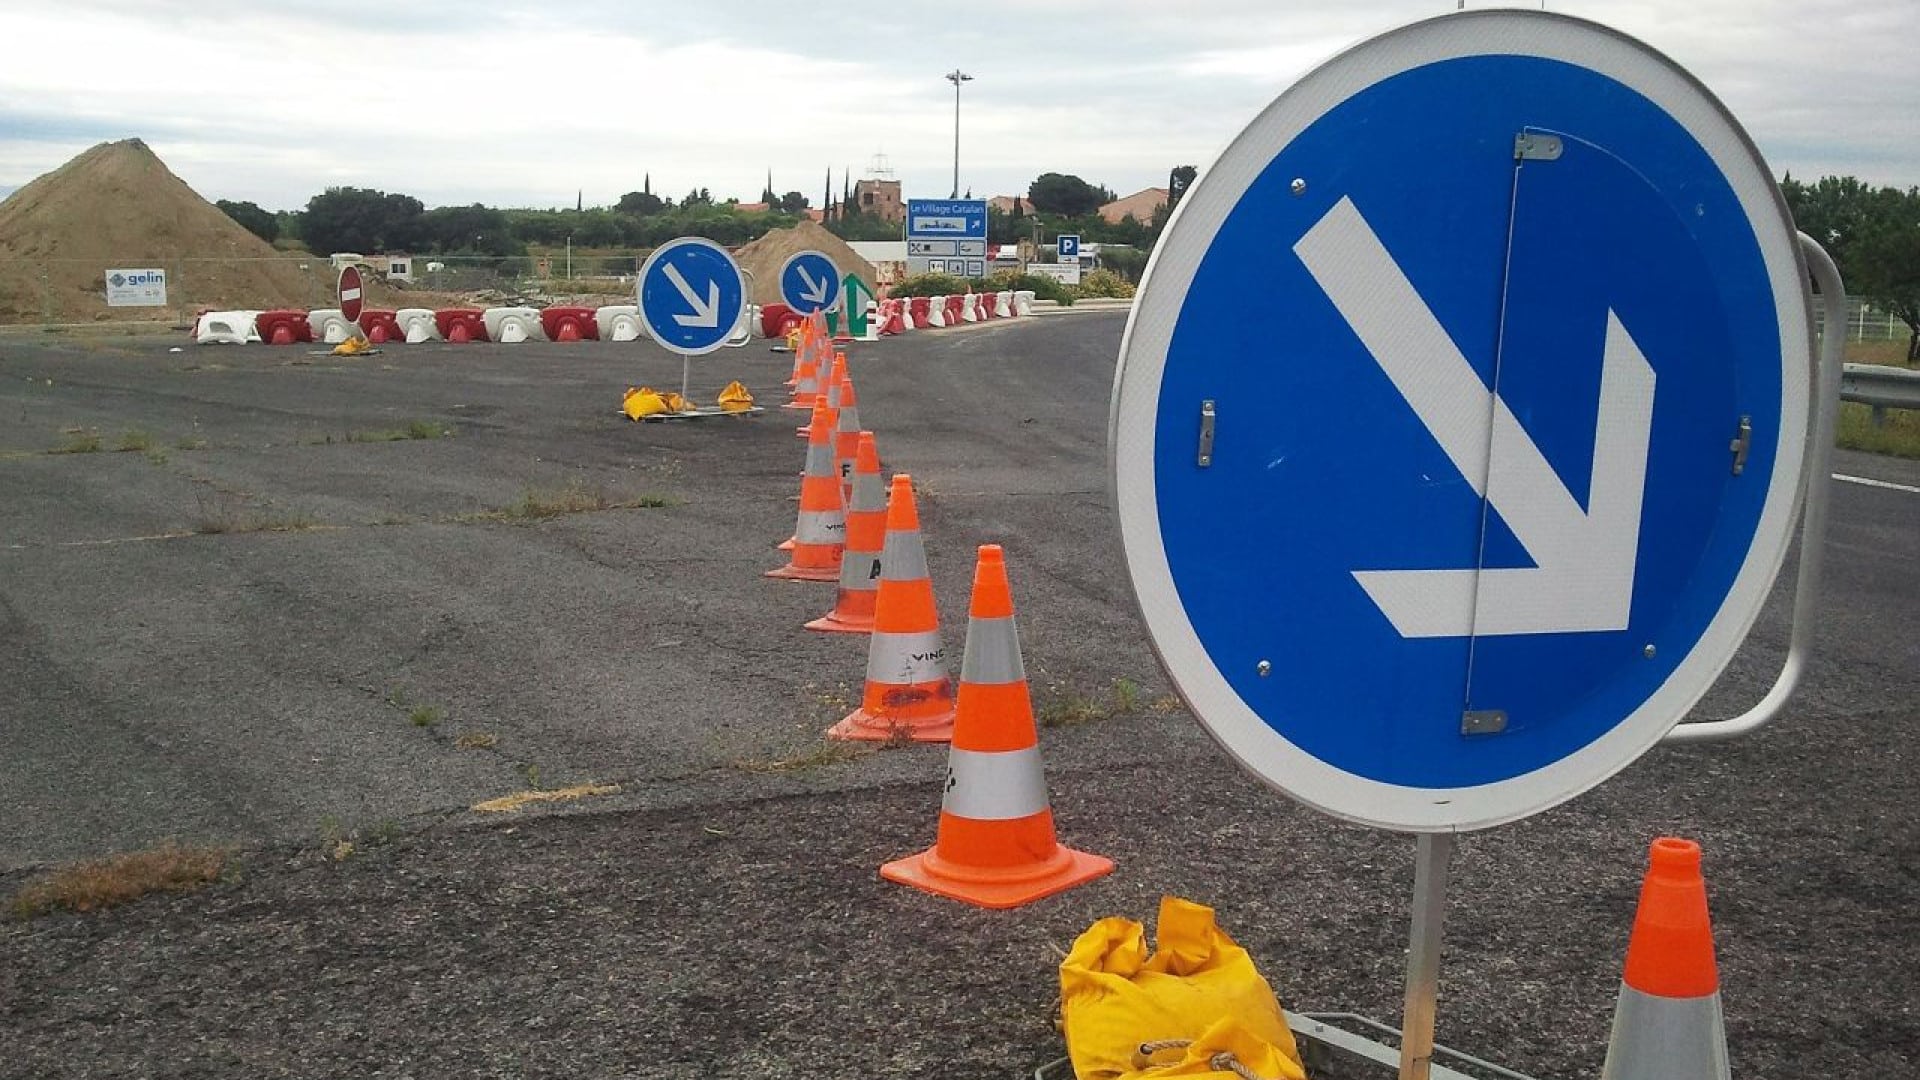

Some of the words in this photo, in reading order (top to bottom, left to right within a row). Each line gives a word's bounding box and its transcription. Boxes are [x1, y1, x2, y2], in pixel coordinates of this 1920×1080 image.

[911, 204, 921, 213] Le
[922, 203, 951, 215] Village
[952, 204, 984, 214] Catalan
[1063, 239, 1074, 253] P
[128, 271, 163, 286] gelin
